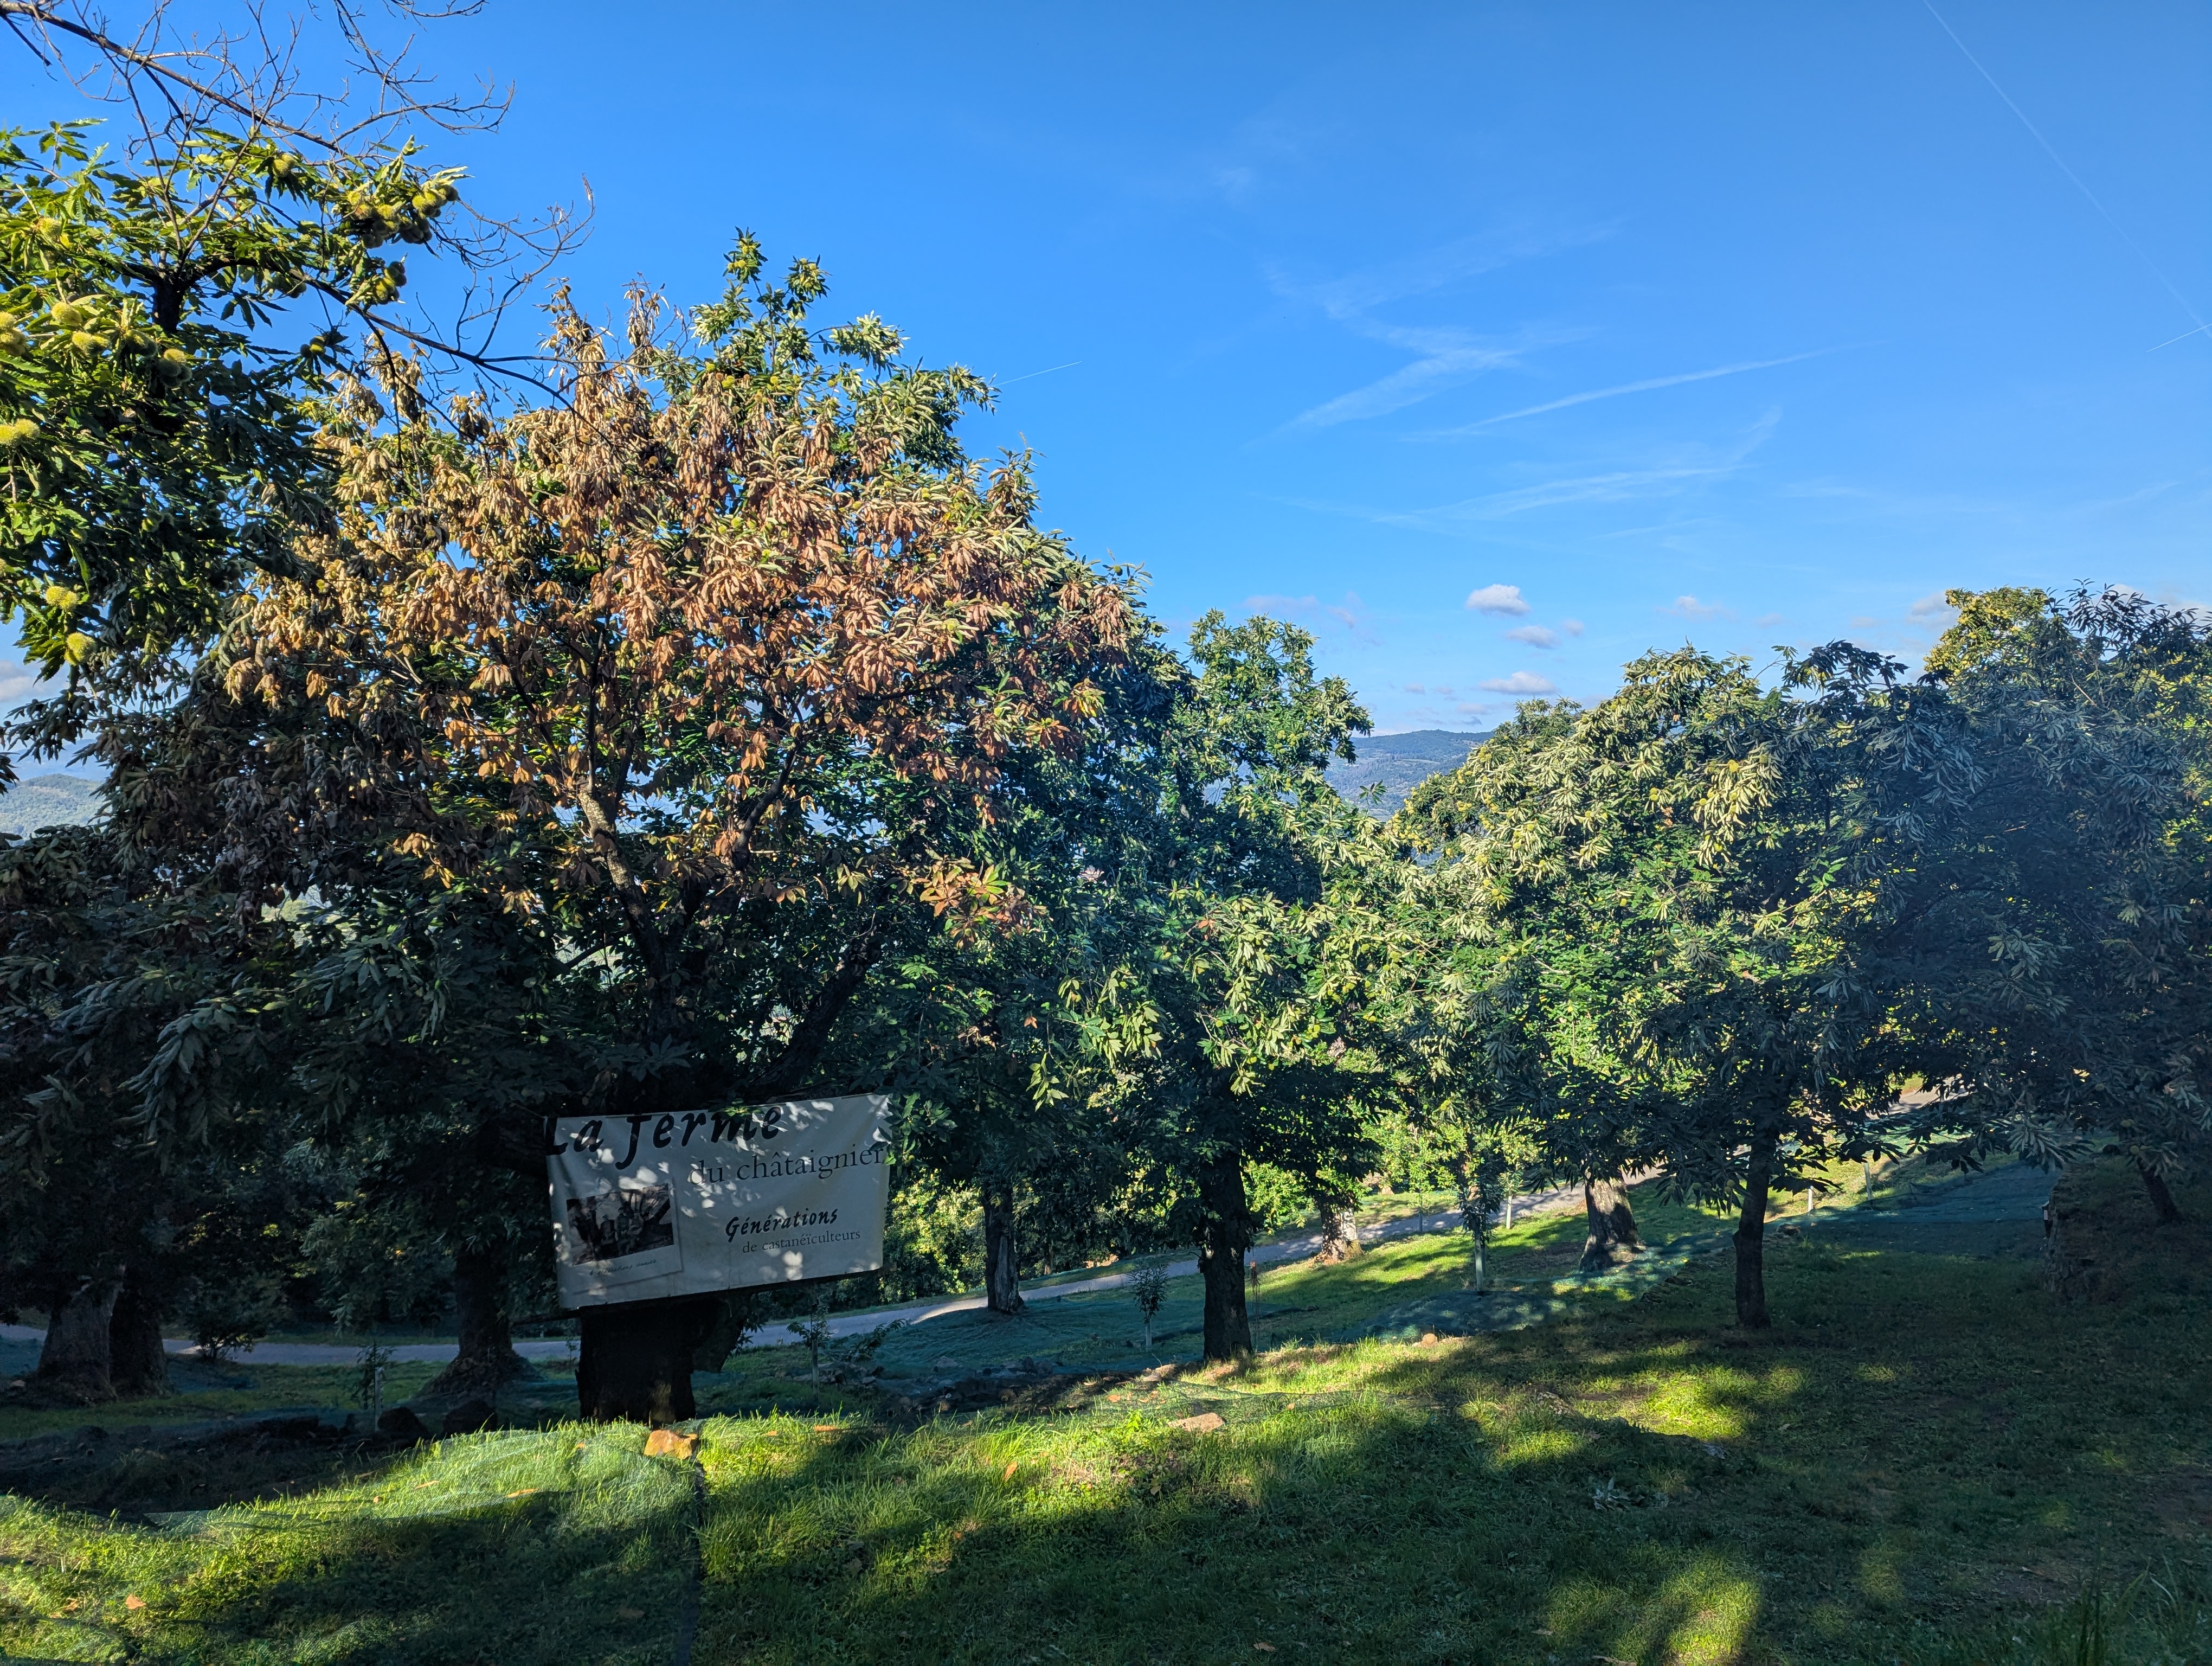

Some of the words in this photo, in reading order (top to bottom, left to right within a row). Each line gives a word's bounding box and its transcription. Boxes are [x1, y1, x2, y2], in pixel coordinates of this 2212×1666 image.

[545, 1117, 603, 1155] La
[690, 1160, 724, 1184] du
[736, 1143, 884, 1181] châtaignier
[725, 1207, 838, 1242] Générations
[742, 1241, 757, 1253] de
[762, 1230, 860, 1251] castanéïculteurs
